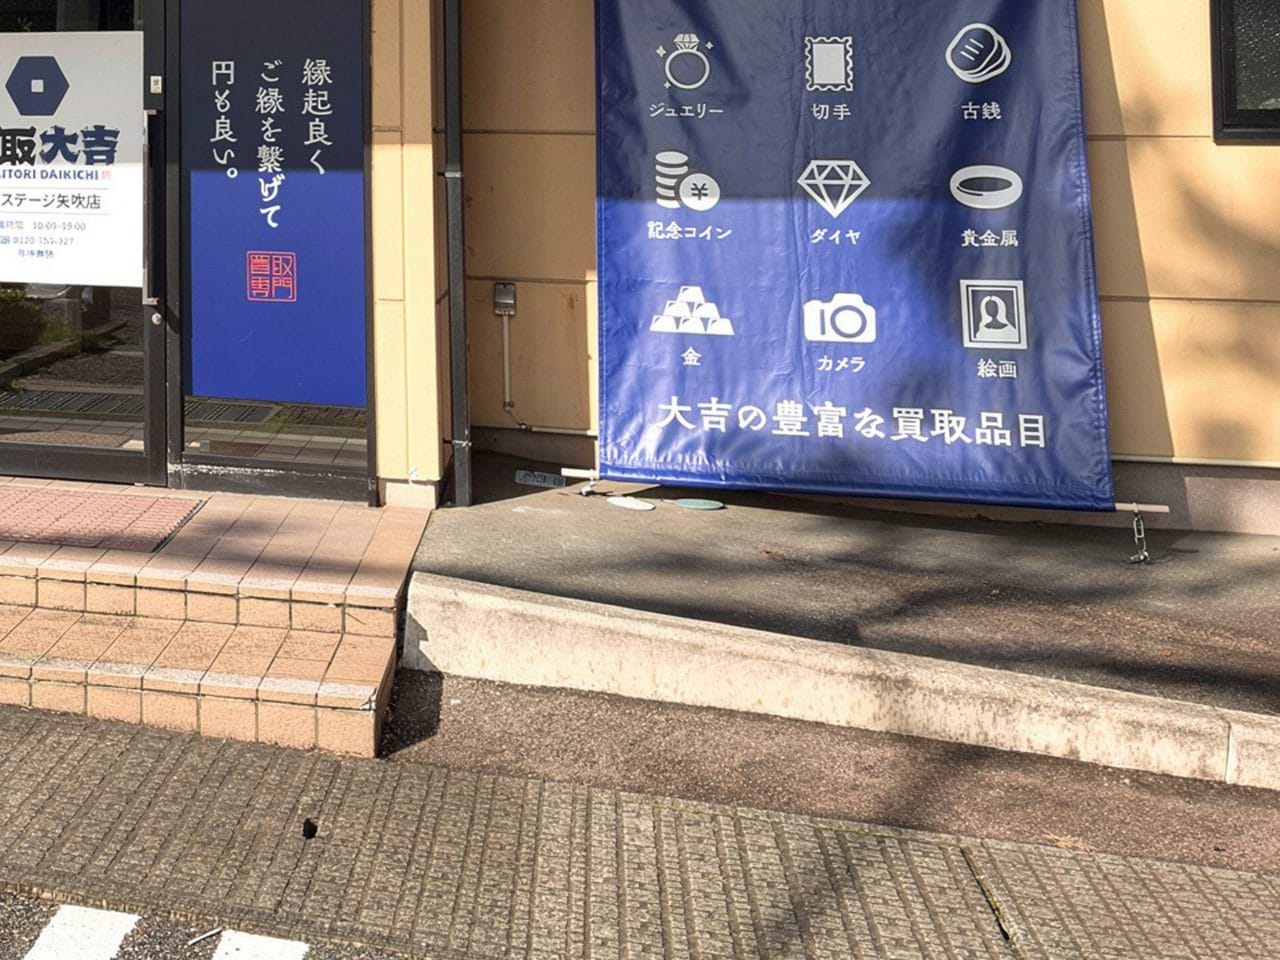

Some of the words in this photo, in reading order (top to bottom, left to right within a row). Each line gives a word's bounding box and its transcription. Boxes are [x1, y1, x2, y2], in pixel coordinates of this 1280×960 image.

[301, 58, 333, 175] 縁起良く
[649, 102, 724, 118] ジュエリー
[811, 103, 851, 120] 切手
[961, 102, 1002, 120] 古銭
[210, 60, 238, 179] 円も良い。
[255, 59, 286, 228] ご縁を繋げて
[40, 169, 99, 180] DAIKICHI
[647, 221, 732, 240] 記念コイン
[810, 229, 861, 245] ダイヤ
[961, 229, 1018, 247] 貴金属
[681, 346, 702, 366] 金
[817, 355, 865, 372] カメラ
[977, 358, 1017, 378] 絵画
[657, 396, 1046, 448] 大吉の豊富な買取品目
